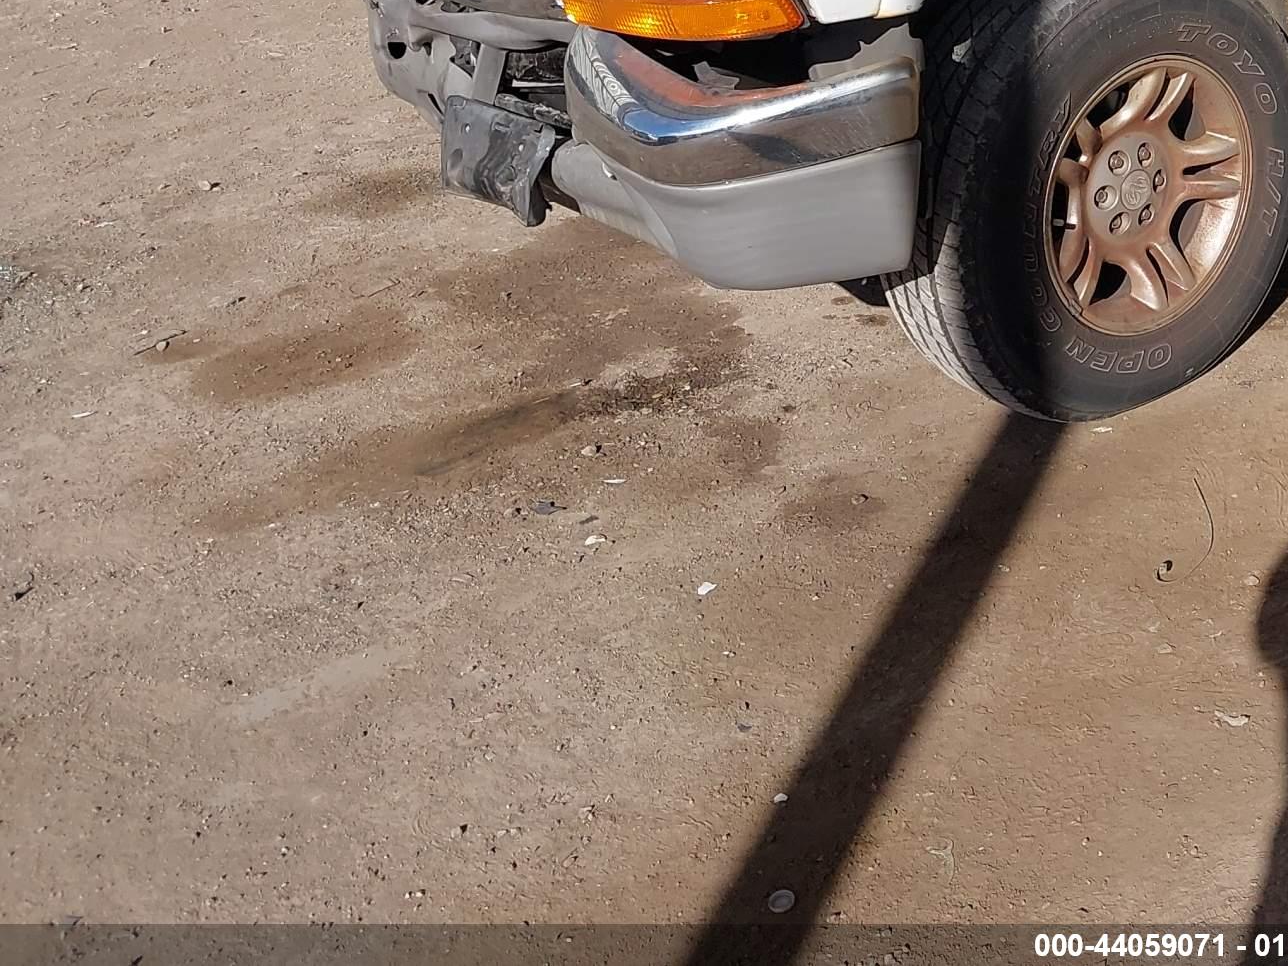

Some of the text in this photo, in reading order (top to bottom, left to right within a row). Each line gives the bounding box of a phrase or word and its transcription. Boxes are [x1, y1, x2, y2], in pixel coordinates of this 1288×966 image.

[1177, 23, 1286, 238] TOYO H/T
[1064, 336, 1172, 374] OPEN
